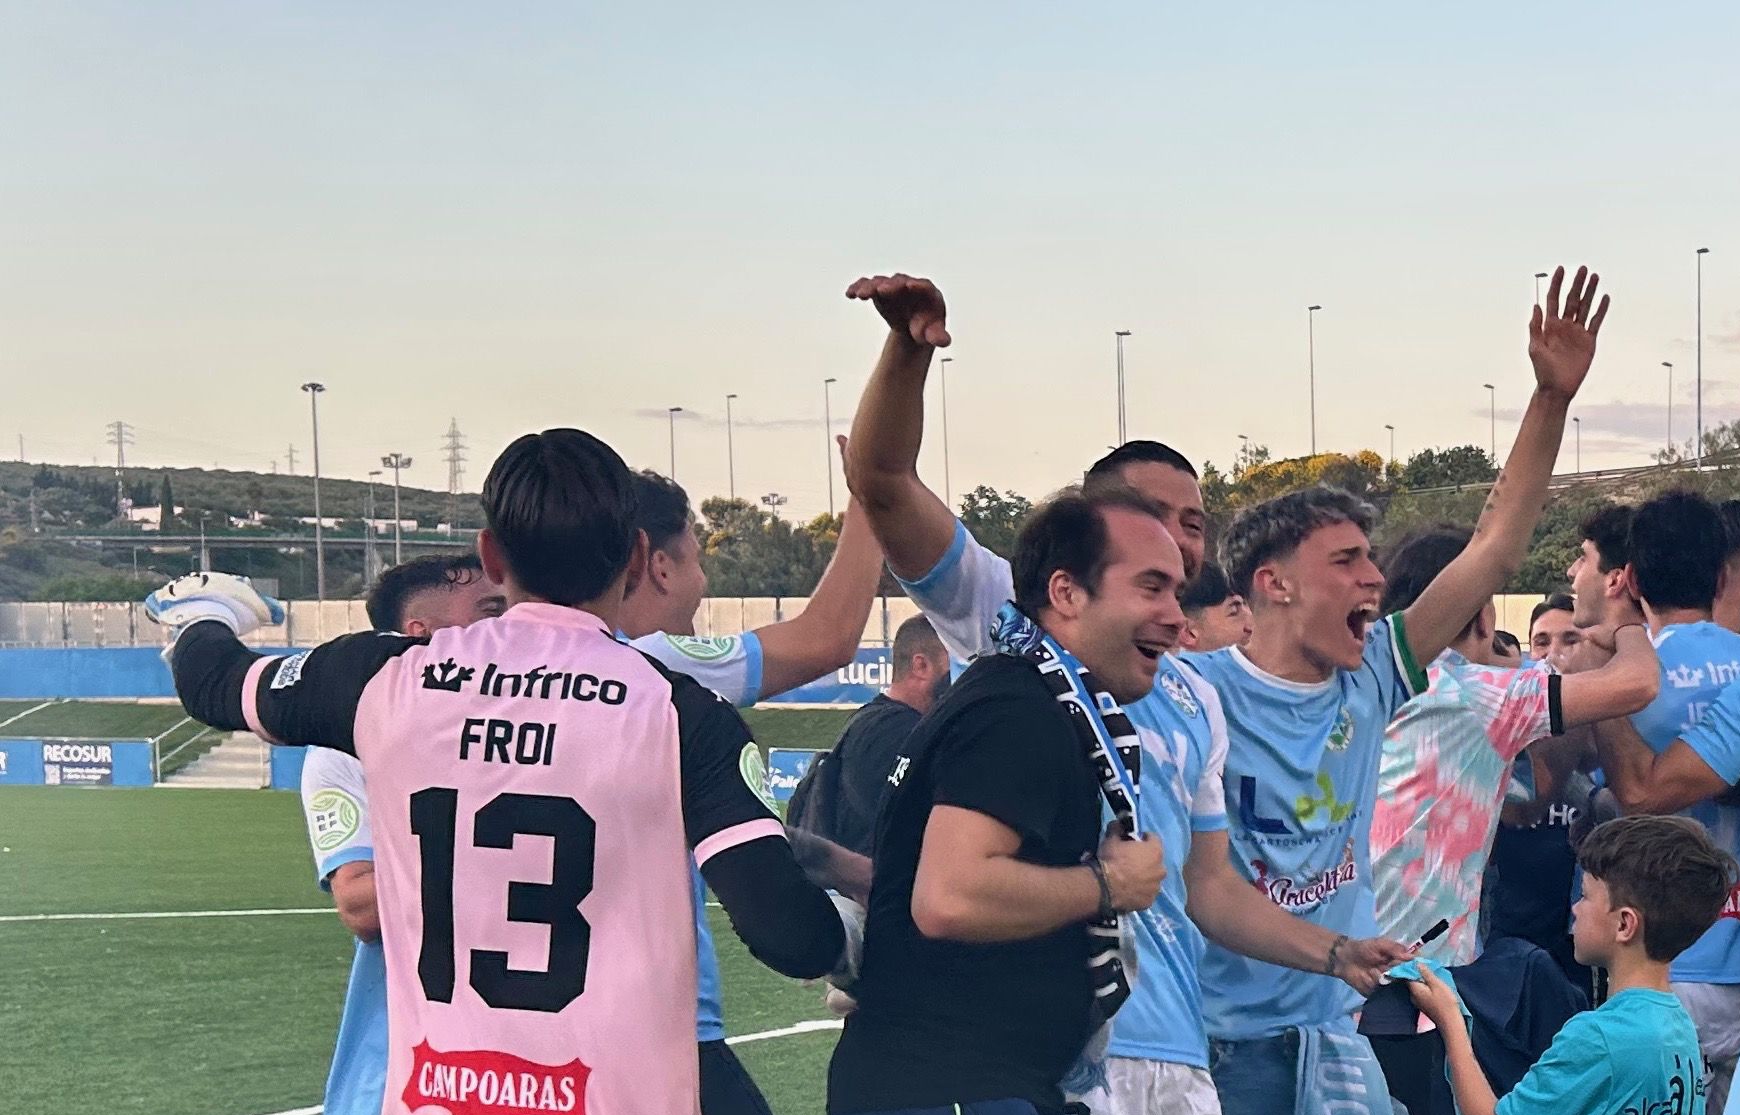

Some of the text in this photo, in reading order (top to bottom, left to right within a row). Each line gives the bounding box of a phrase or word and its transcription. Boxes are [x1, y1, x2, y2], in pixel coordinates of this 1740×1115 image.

[479, 662, 628, 705] Infrico
[44, 744, 112, 763] RECOSUR
[459, 718, 557, 765] FROI
[408, 787, 597, 1013] 13
[418, 1061, 576, 1111] CAMPOARAS
